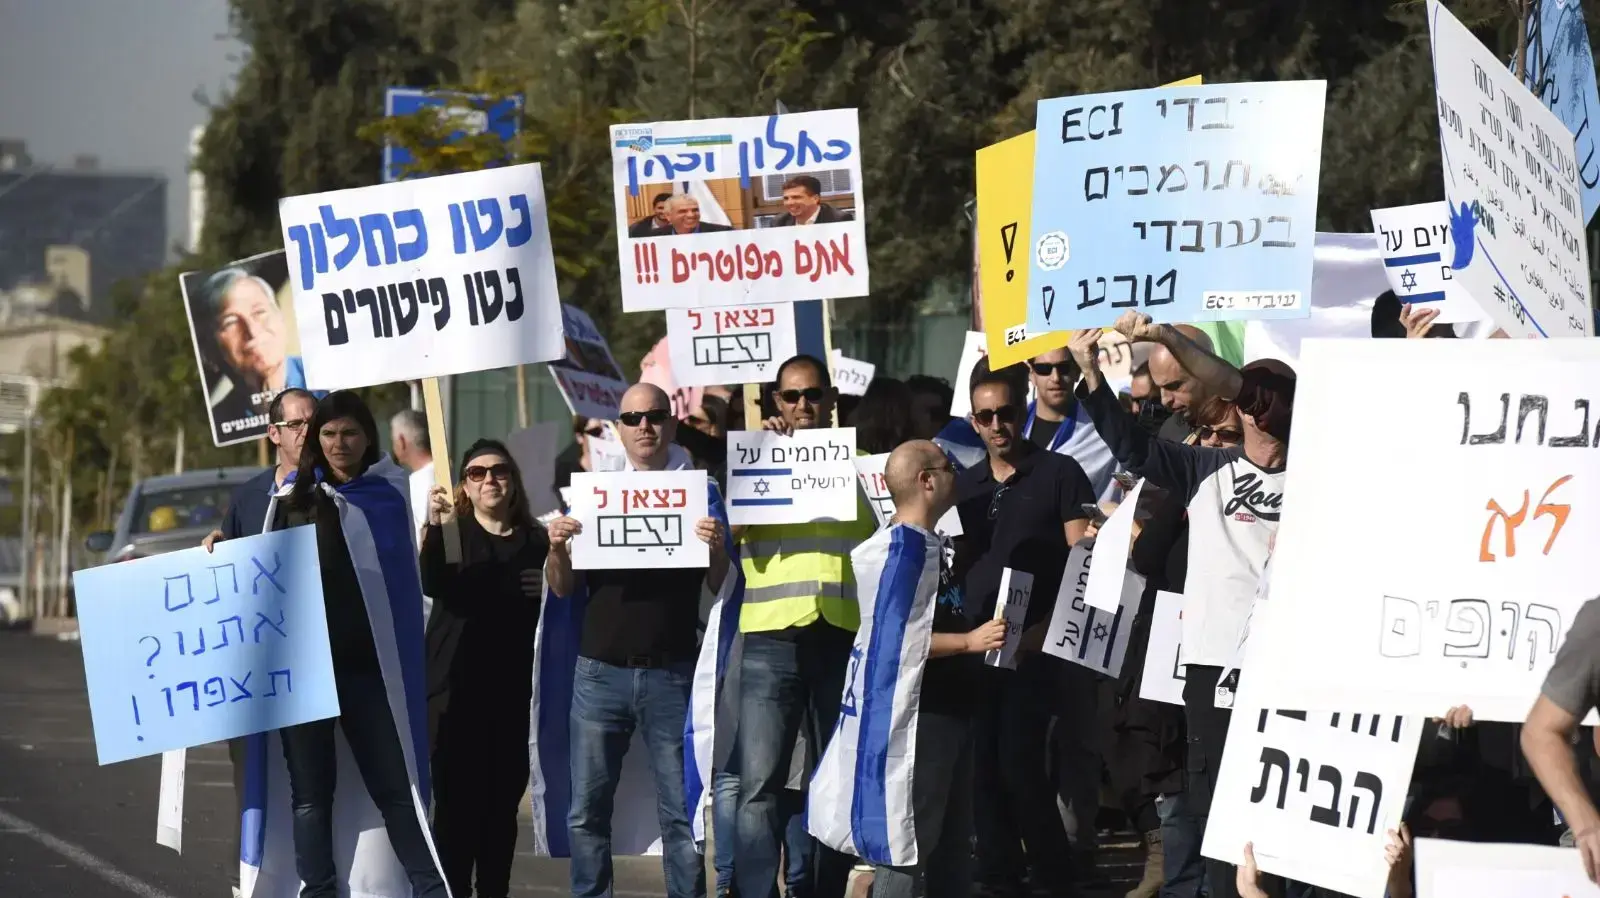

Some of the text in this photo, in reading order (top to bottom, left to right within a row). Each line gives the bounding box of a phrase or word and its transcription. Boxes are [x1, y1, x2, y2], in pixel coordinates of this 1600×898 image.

[1062, 102, 1124, 144] ECI
[739, 115, 852, 189] כחלון
[288, 194, 533, 290] נטו כחלון
[1132, 215, 1296, 253] בעובדי
[1379, 224, 1403, 252] על
[672, 243, 782, 284] מפוטרים
[795, 233, 854, 282] אתם
[322, 267, 525, 346] נטו פיטורים
[1076, 269, 1177, 310] טבע
[1206, 294, 1296, 309] עובדי ECI
[715, 308, 775, 334] כצאן
[1457, 391, 1600, 449] נחנו
[736, 440, 850, 464] נלחמים על
[593, 486, 687, 514] כצאן ל
[791, 473, 850, 491] ירושלים
[1479, 474, 1574, 563] לא
[163, 552, 287, 612] אתם
[1056, 620, 1080, 647] על
[1249, 746, 1384, 835] הבית
